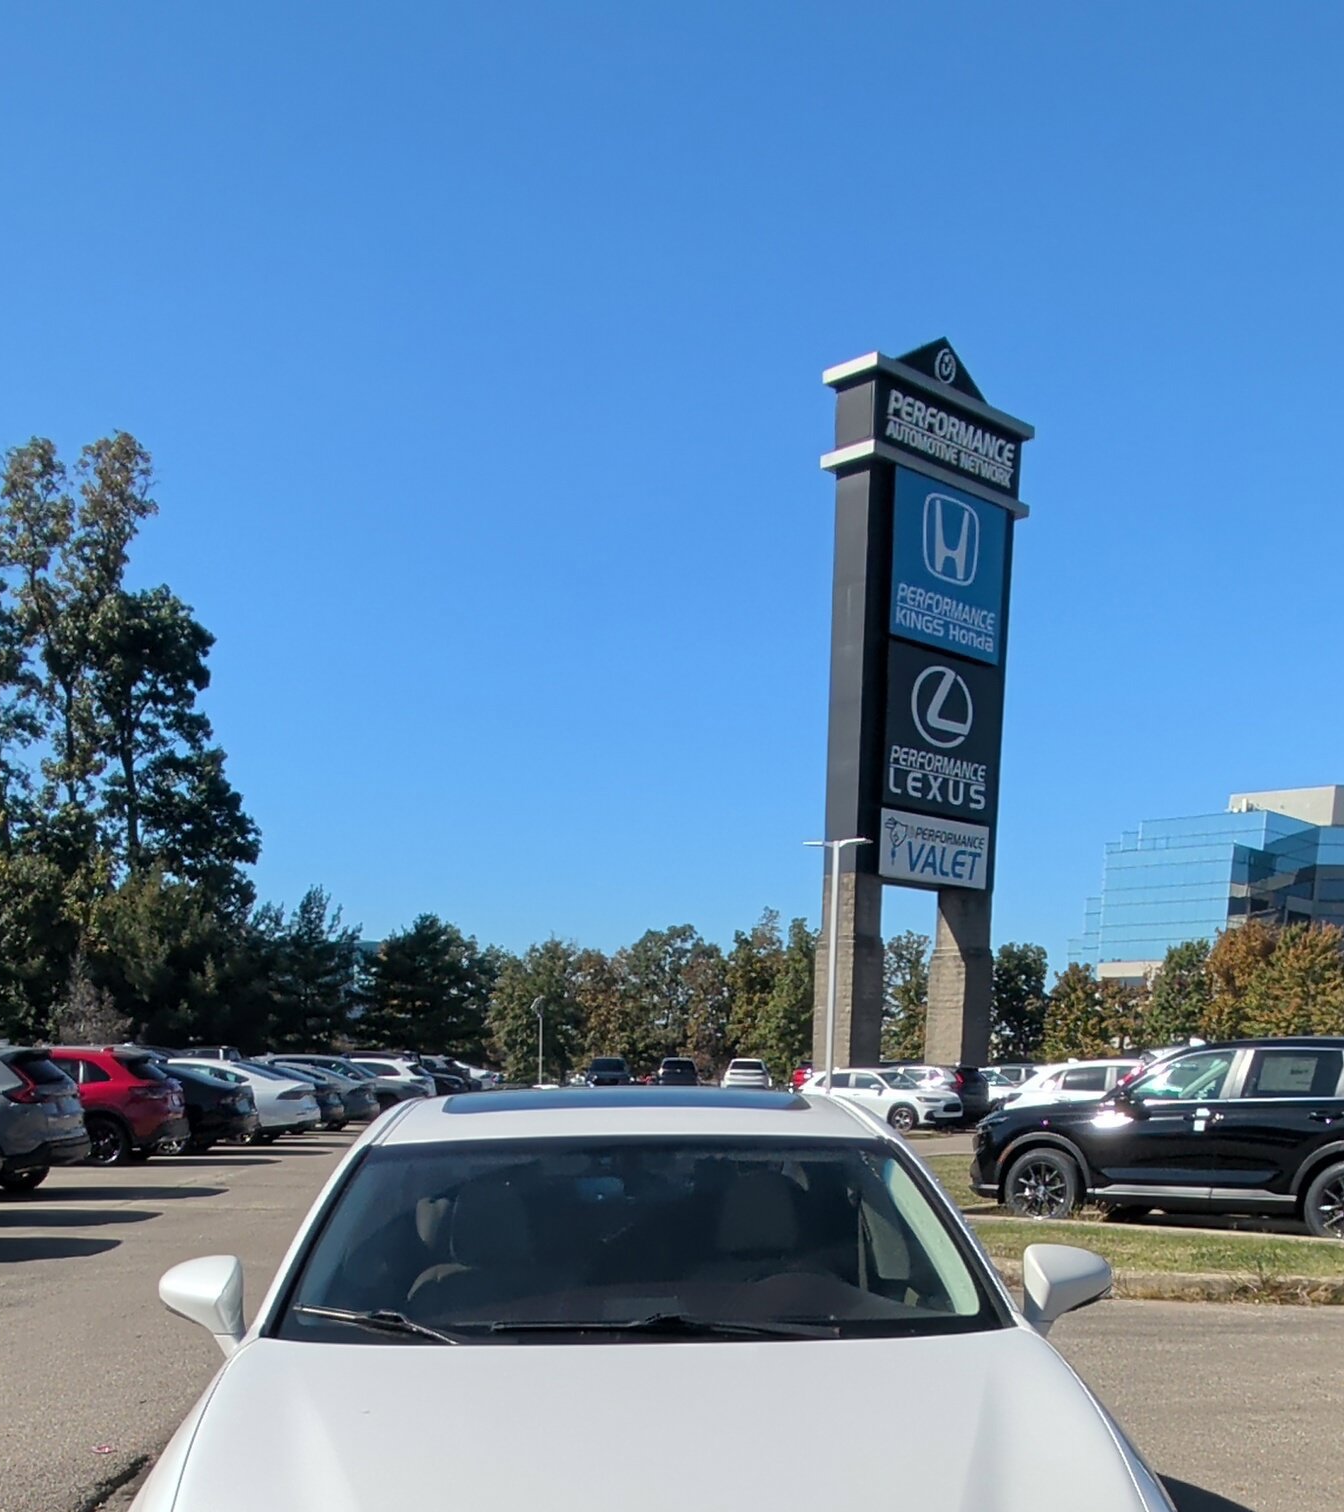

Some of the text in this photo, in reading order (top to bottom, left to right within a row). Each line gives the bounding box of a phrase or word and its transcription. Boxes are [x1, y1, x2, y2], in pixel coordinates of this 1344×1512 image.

[888, 389, 1015, 466] PERFORMANCE
[886, 420, 1013, 488] AUTOMOTIVE NETWORK
[897, 583, 995, 630] PERFORMANCE
[896, 607, 994, 652] KINGS Honda
[889, 745, 986, 782] PERFORMANCE
[889, 767, 986, 810] LEXUS
[908, 841, 981, 880] VALET
[916, 827, 985, 850] PERFORMANCE
